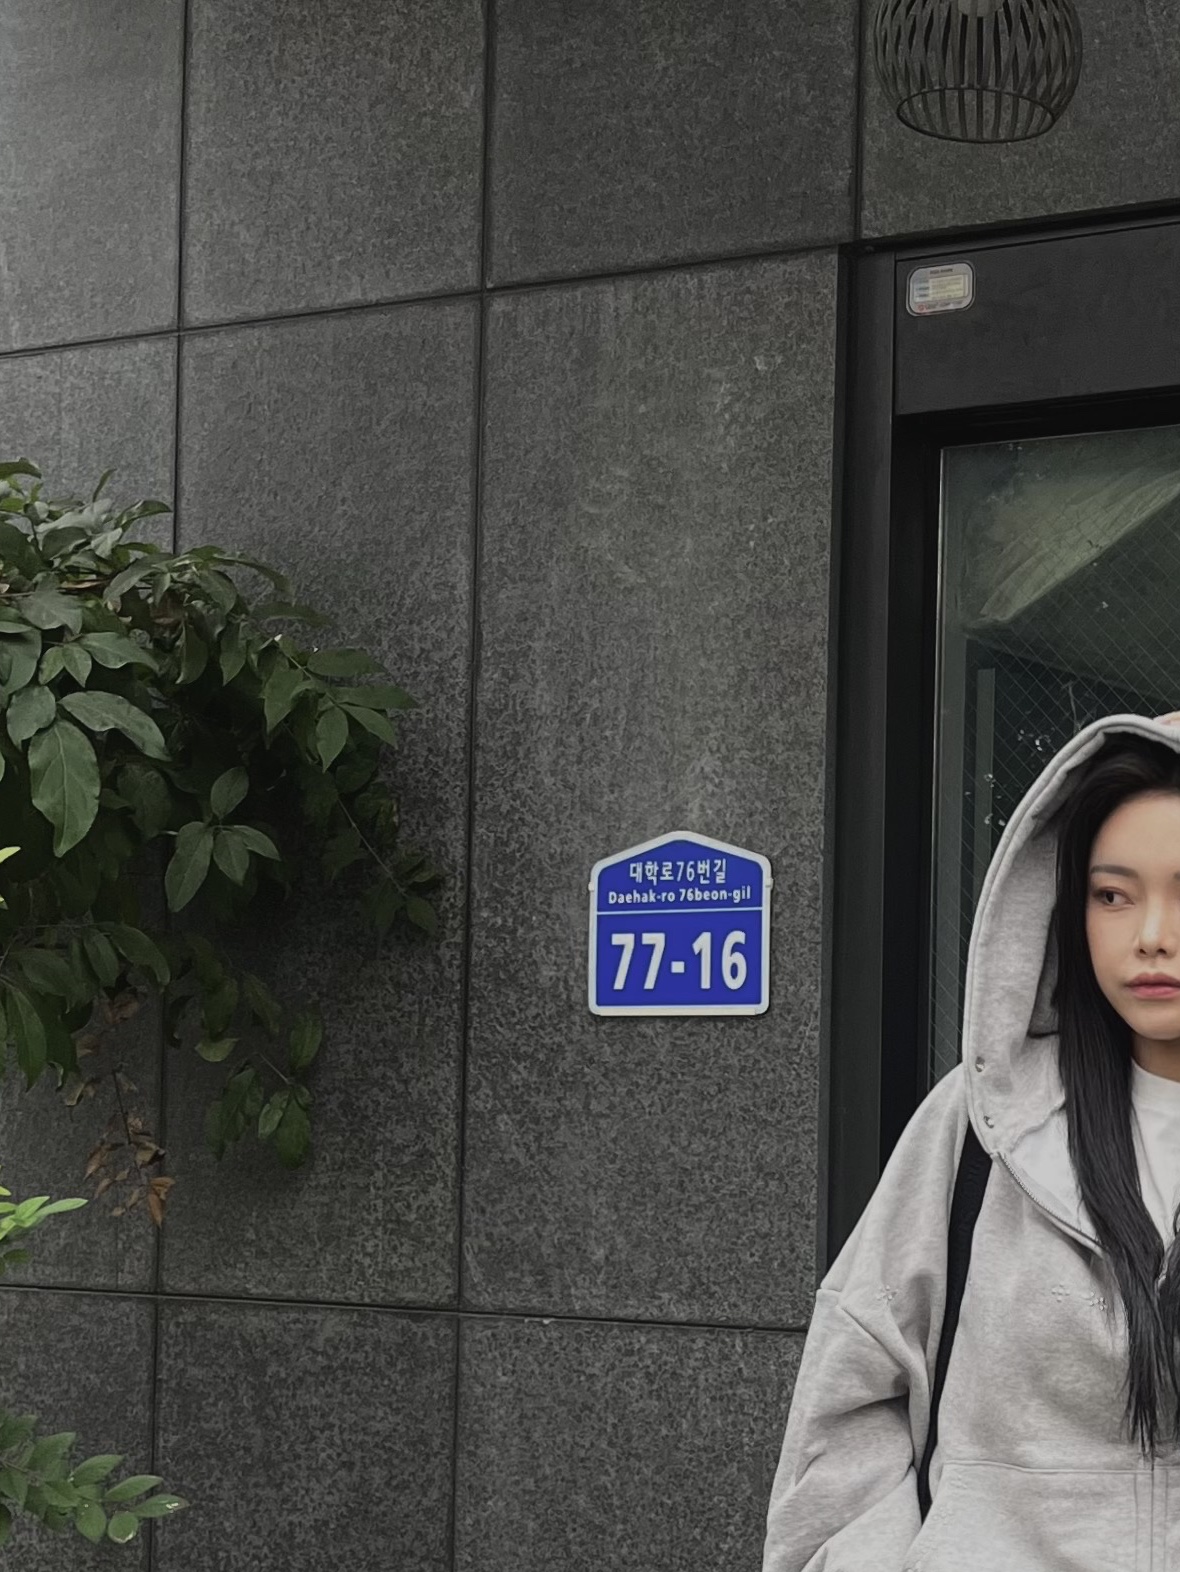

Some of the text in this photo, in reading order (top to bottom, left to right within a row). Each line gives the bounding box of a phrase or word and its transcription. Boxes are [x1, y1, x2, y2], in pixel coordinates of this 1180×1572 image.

[629, 858, 727, 885] 대학로76번길
[608, 886, 751, 904] Daehak-ro 76beon-gil
[611, 930, 747, 990] 77-16
